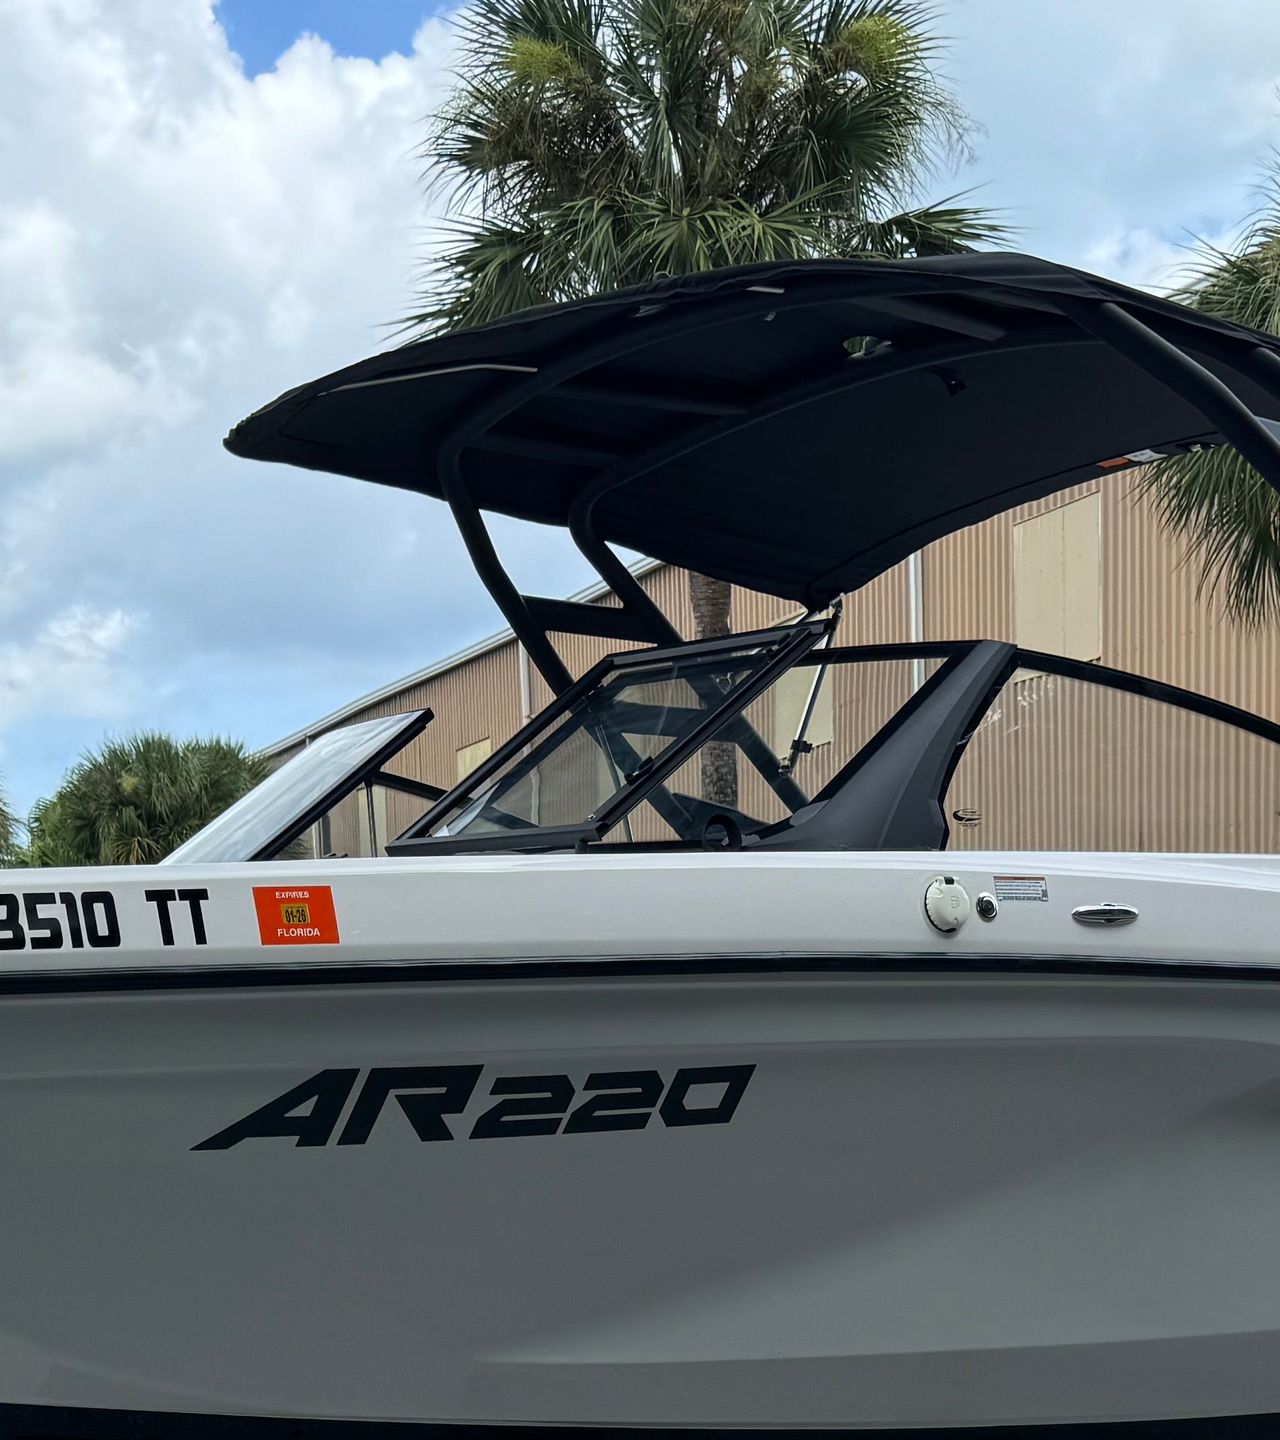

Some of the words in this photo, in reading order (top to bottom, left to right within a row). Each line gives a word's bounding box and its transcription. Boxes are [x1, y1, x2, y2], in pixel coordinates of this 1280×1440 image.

[275, 891, 310, 899] EXPIRES
[145, 888, 209, 945] TT
[277, 927, 320, 937] FLORIDA
[190, 1064, 757, 1151] AR220
